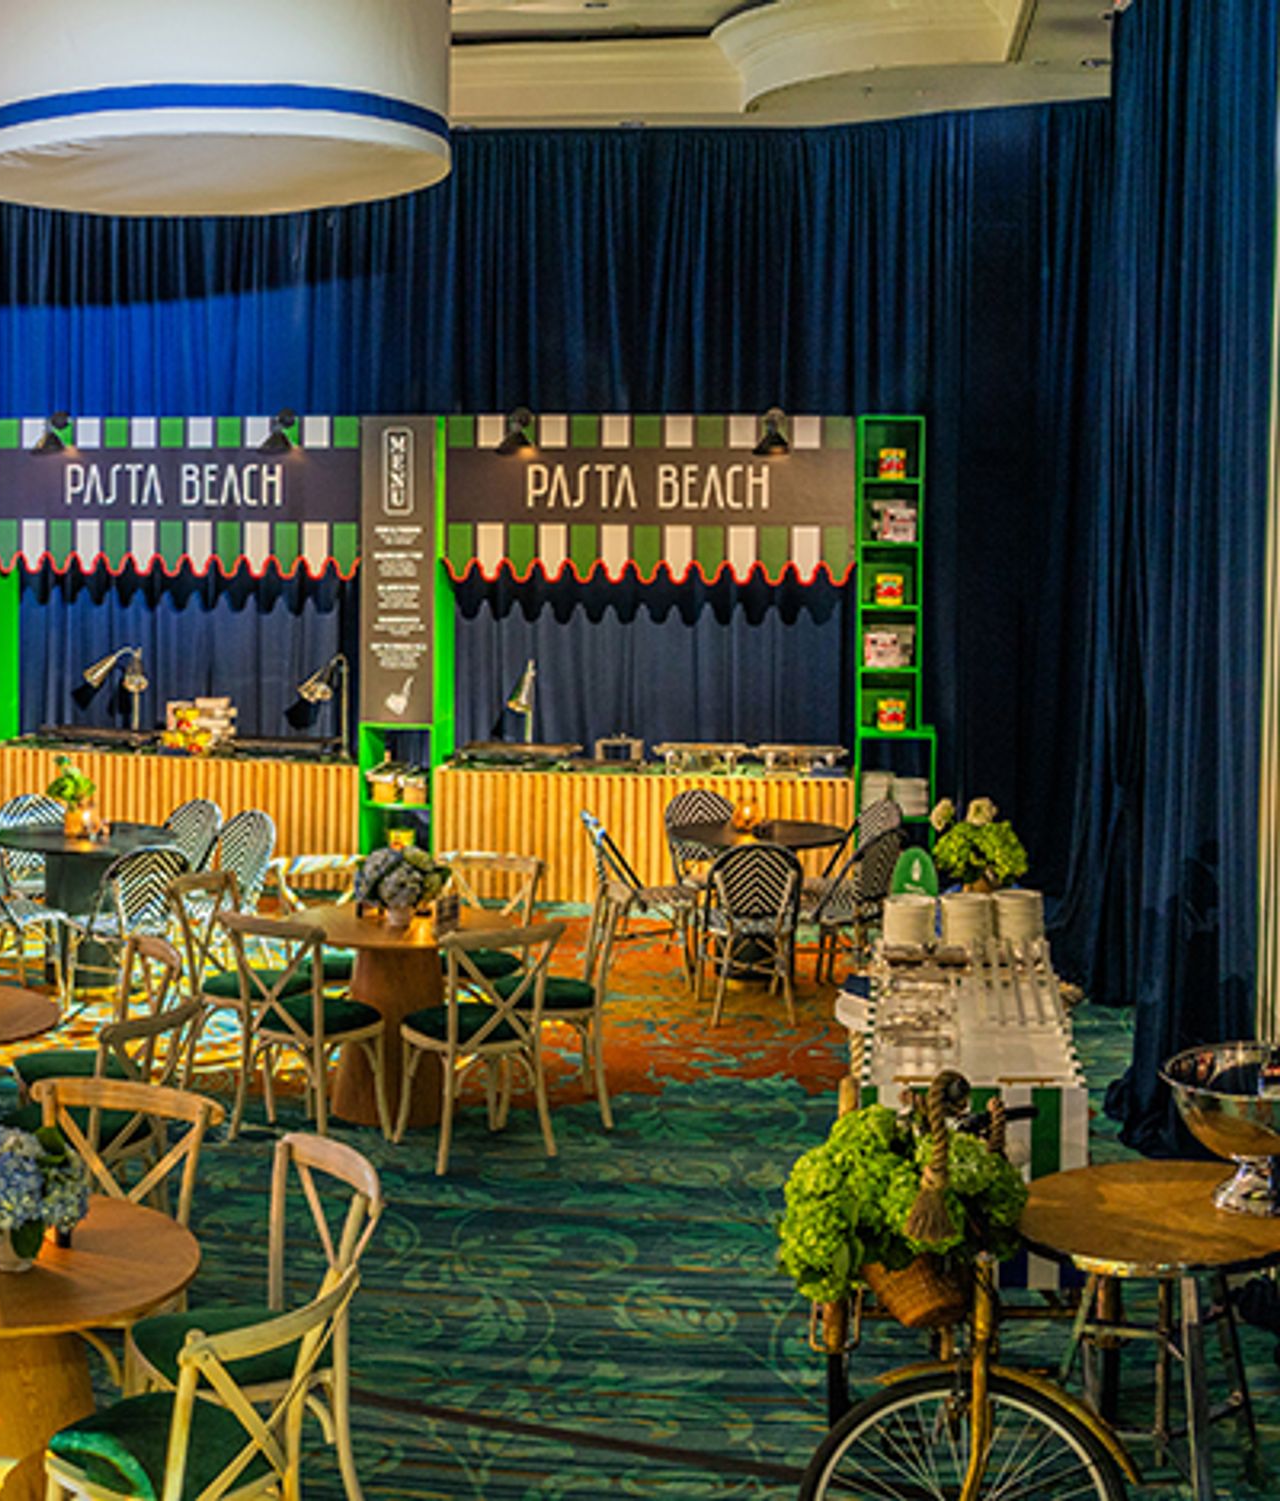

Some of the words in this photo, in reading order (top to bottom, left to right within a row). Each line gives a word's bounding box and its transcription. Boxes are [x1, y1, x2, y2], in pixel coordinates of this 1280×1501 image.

[64, 463, 164, 506] PASTA
[181, 463, 284, 506] BEACH
[389, 434, 406, 507] MENU
[526, 464, 638, 508] PASTA
[656, 464, 771, 508] BEACH
